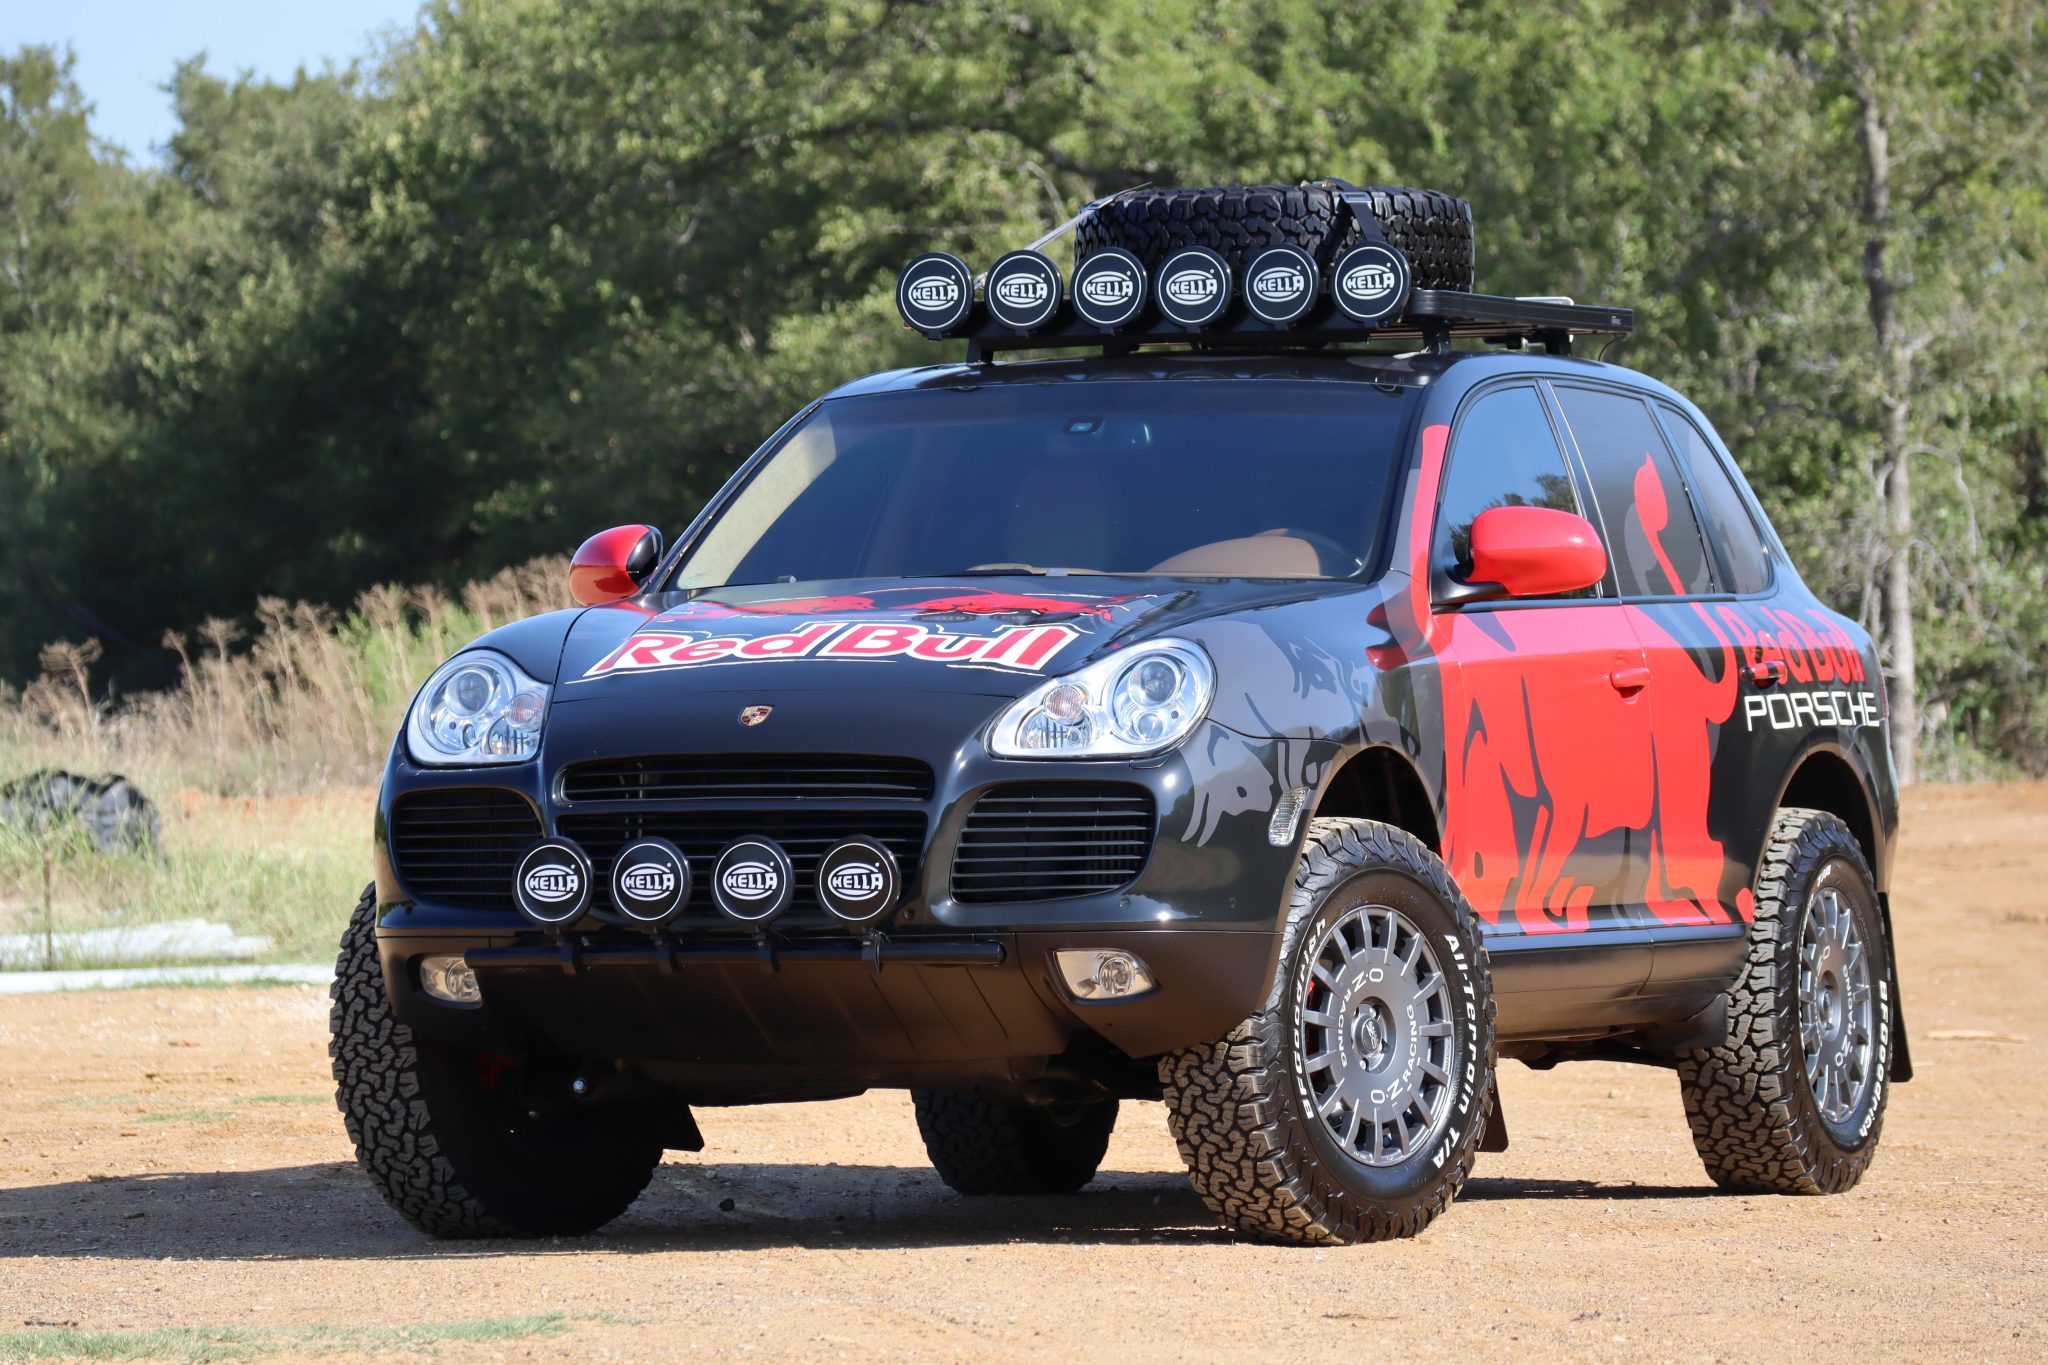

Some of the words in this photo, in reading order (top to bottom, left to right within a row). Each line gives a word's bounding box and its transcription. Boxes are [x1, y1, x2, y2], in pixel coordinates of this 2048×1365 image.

[1086, 281, 1133, 297] HELLA
[1170, 279, 1217, 294] HELLA
[1257, 275, 1304, 291] HELLA
[1347, 273, 1394, 288] HELLA
[911, 285, 958, 300] HELLA
[1000, 282, 1048, 299] HELLA
[590, 623, 824, 673] Red
[818, 625, 1076, 668] Bull
[1774, 608, 1865, 684] Bull
[1744, 691, 1880, 731] PORSCHE
[530, 874, 578, 892] HELLA
[626, 872, 674, 890] HELLA
[727, 871, 777, 890] HELLA
[832, 873, 883, 890] HELLA
[1338, 988, 1351, 1068] RACING
[1444, 934, 1478, 1116] All-Terrain
[1402, 1004, 1418, 1083] RACING
[1432, 1126, 1460, 1169] T/A
